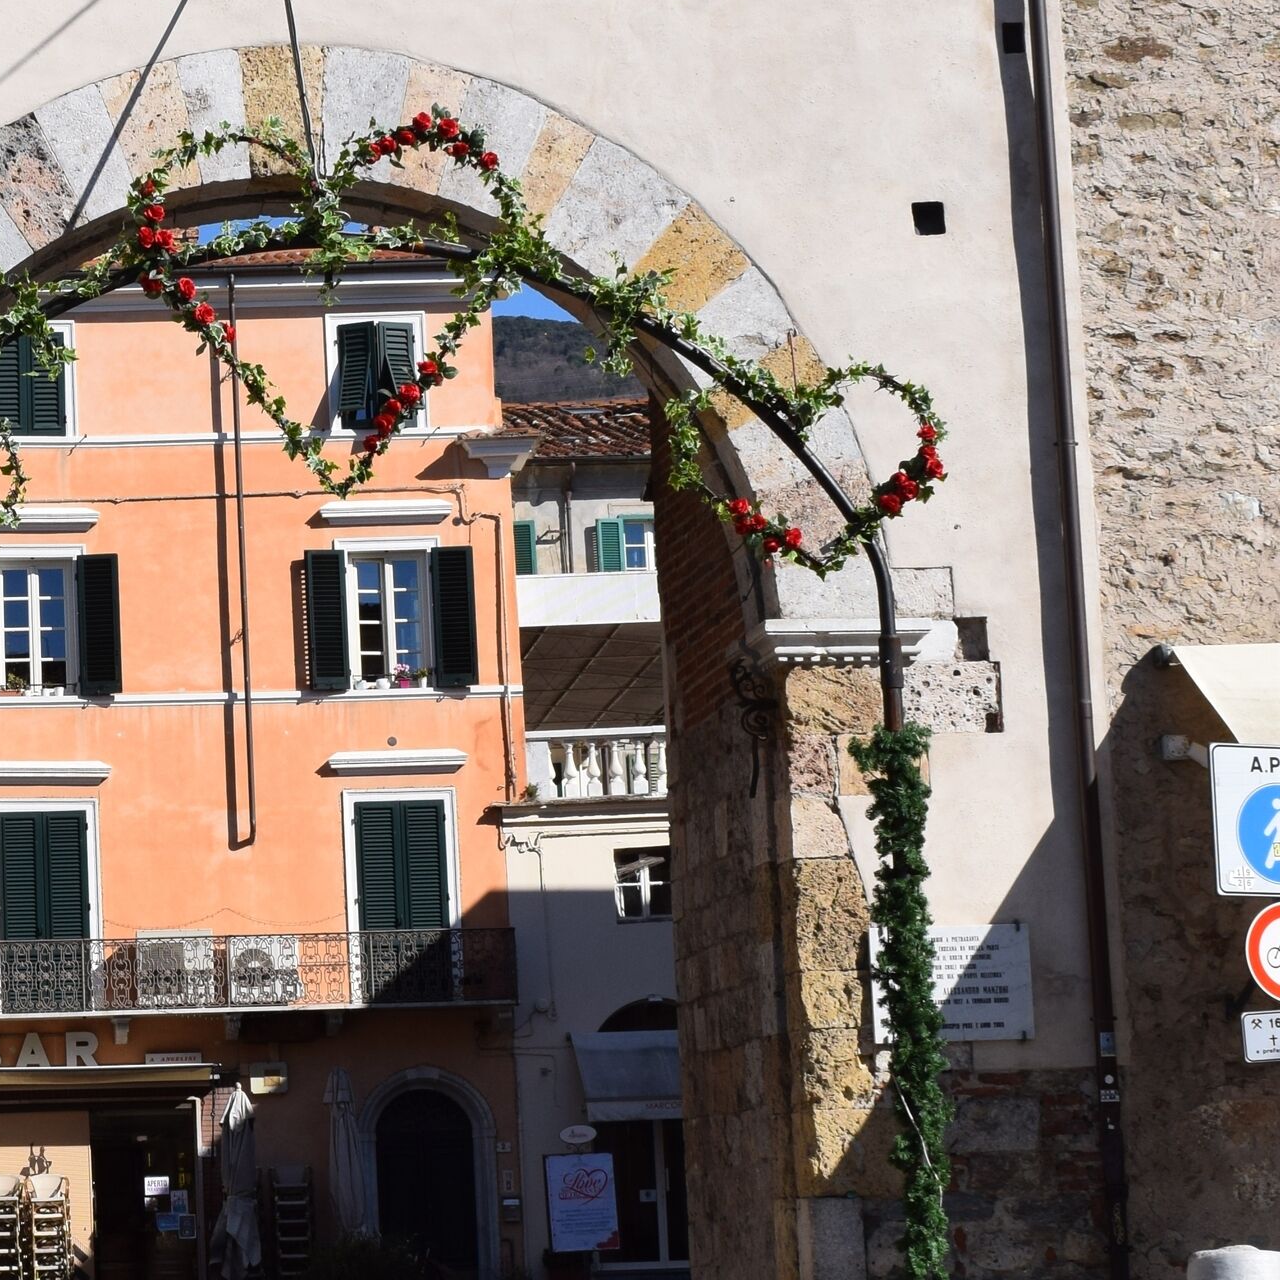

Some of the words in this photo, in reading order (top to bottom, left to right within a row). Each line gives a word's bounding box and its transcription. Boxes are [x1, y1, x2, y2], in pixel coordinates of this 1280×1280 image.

[943, 987, 980, 995] ALESSANDRO
[982, 985, 1009, 994] MANZONI
[147, 1179, 168, 1188] APERTO
